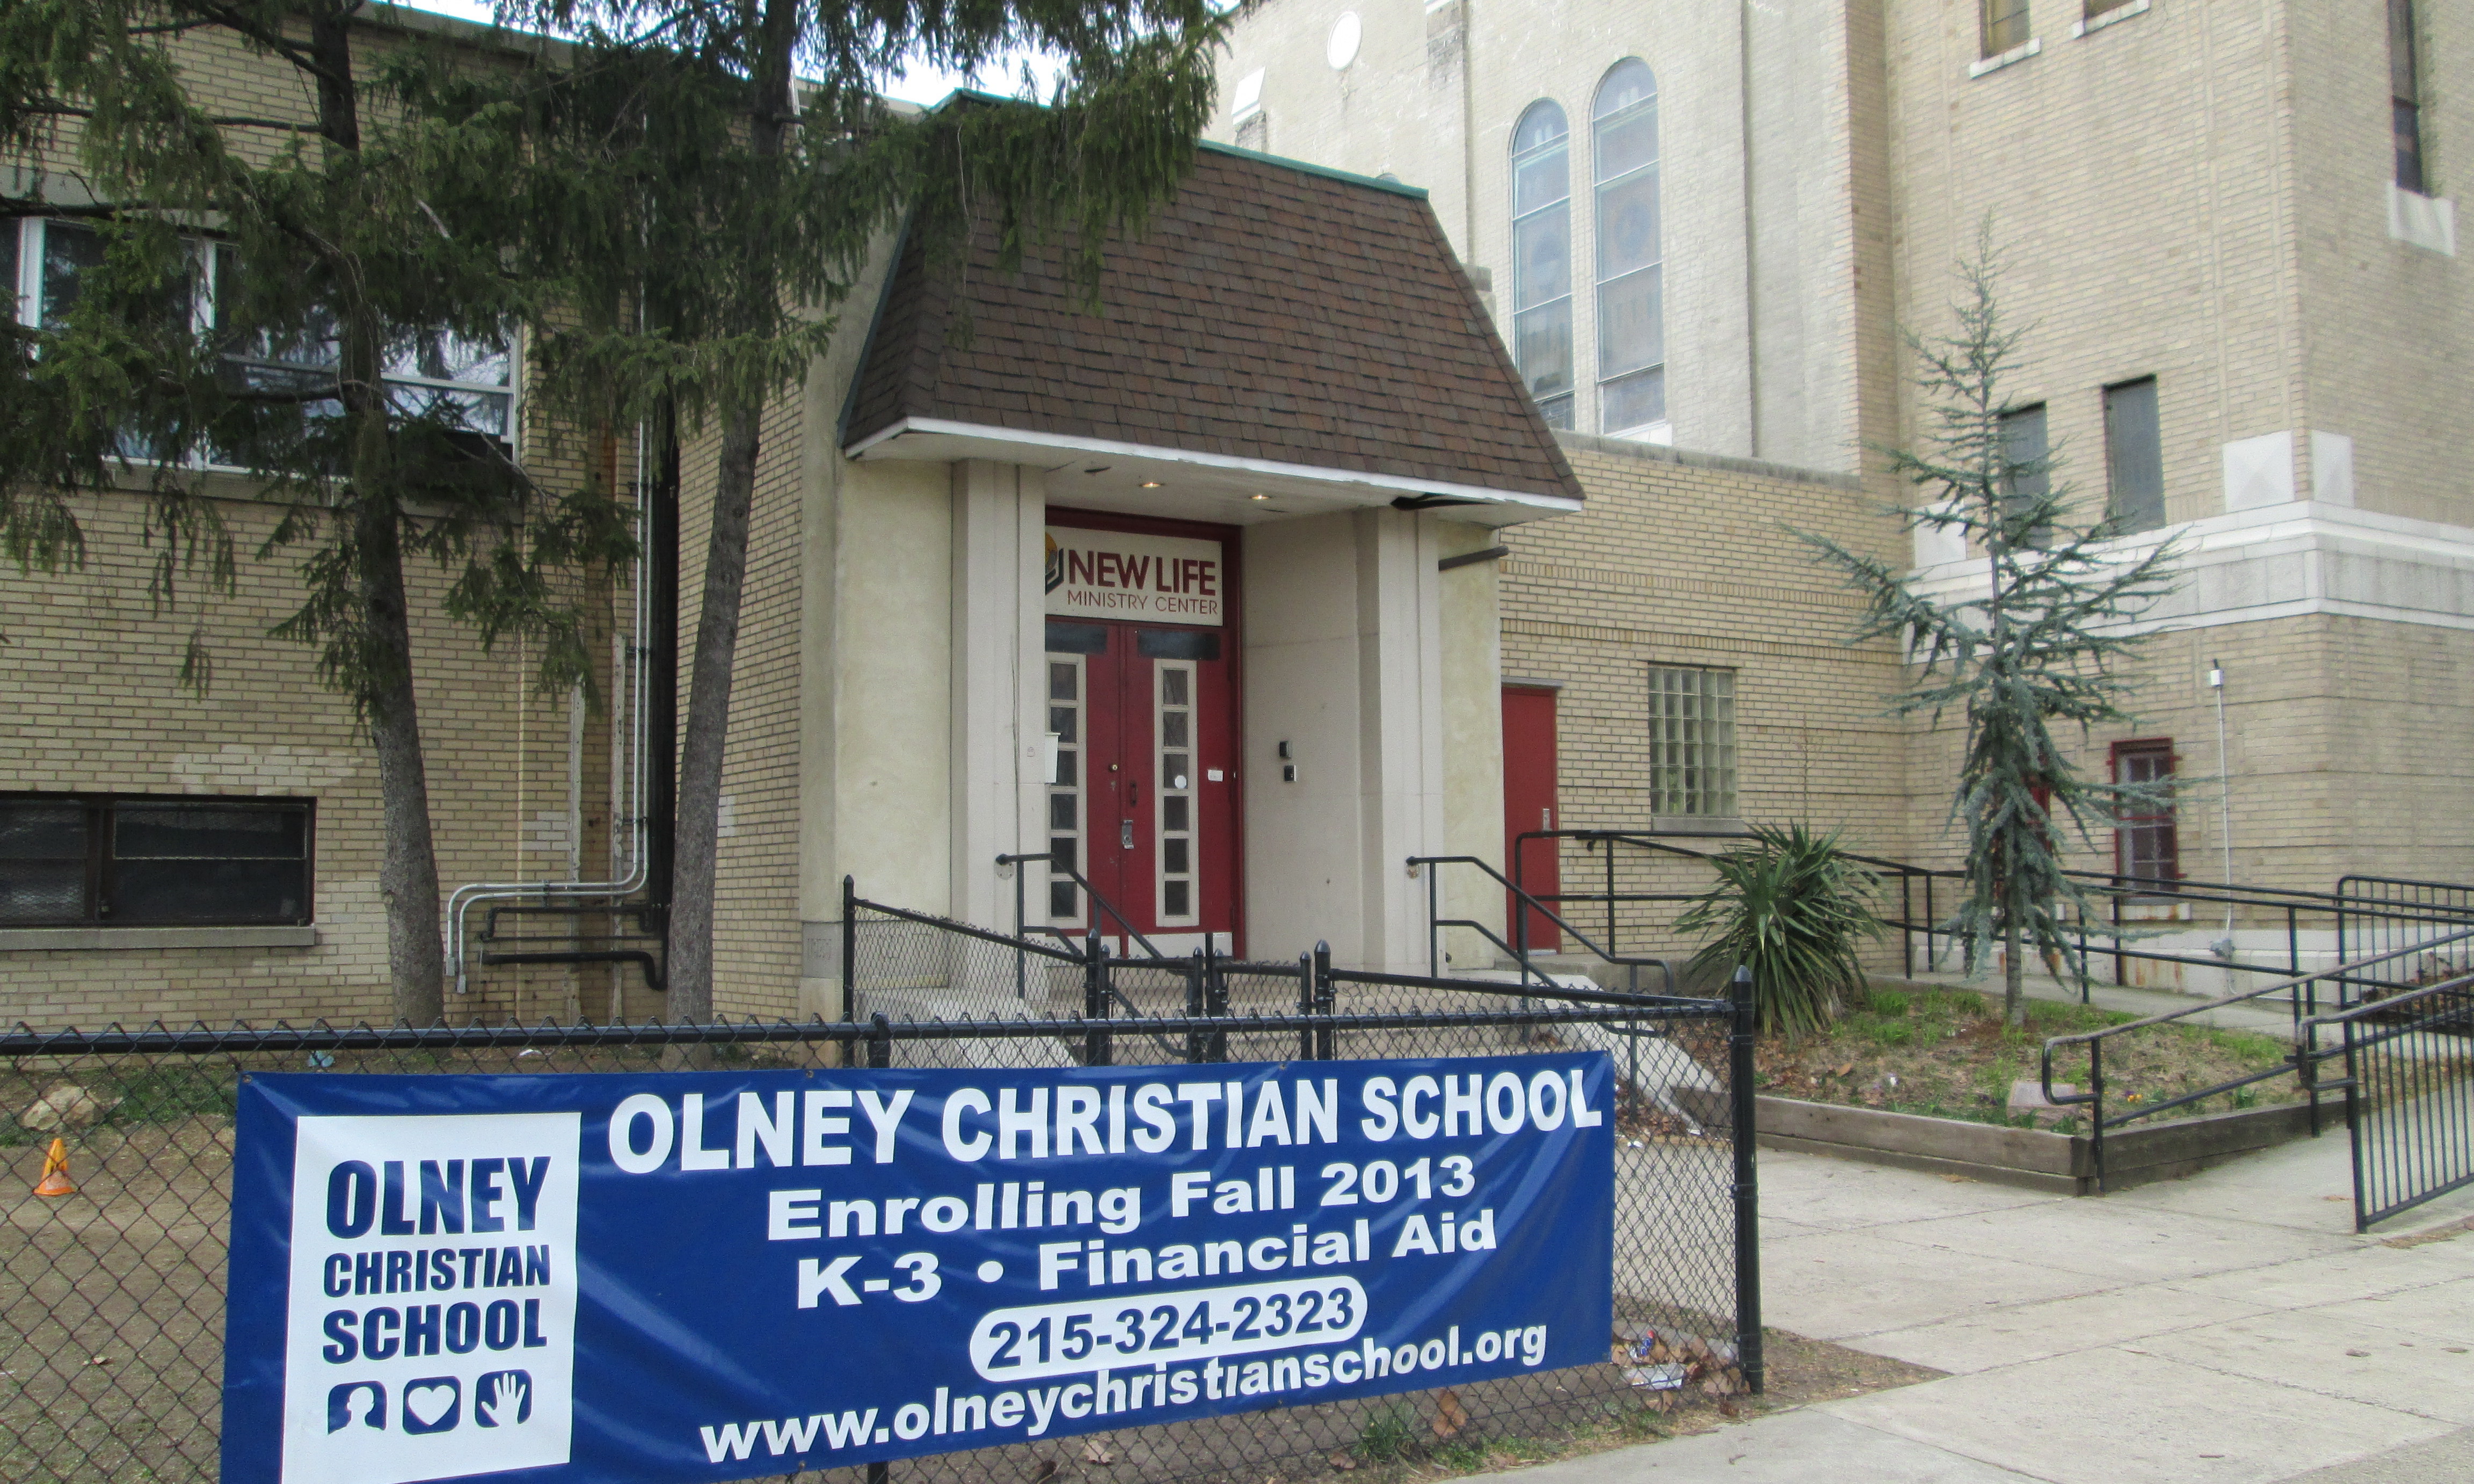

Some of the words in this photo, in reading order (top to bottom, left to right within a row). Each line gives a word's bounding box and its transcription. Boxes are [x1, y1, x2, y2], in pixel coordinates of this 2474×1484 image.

[1067, 590, 1148, 610] MINISTRY
[1155, 596, 1218, 615] CENTER
[1068, 549, 1150, 590] NEW
[1156, 556, 1216, 596] LIFE
[609, 1090, 915, 1174] OLNEY
[943, 1079, 1337, 1161] CHRISTIAN
[1362, 1070, 1602, 1141] SCHOOL
[326, 1156, 550, 1239] OLNEY
[769, 1182, 1140, 1234] Enrolling
[1172, 1167, 1294, 1217] Fall
[1321, 1156, 1474, 1206] 2013
[324, 1245, 550, 1298] CHRISTIAN
[798, 1253, 941, 1308] K-3
[1040, 1219, 1369, 1290] Financial
[1392, 1209, 1496, 1257] Aid
[323, 1299, 547, 1364] SCHOOL
[988, 1287, 1353, 1369] 215-324-2323
[700, 1326, 1546, 1463] www.olneychristianschool.org
